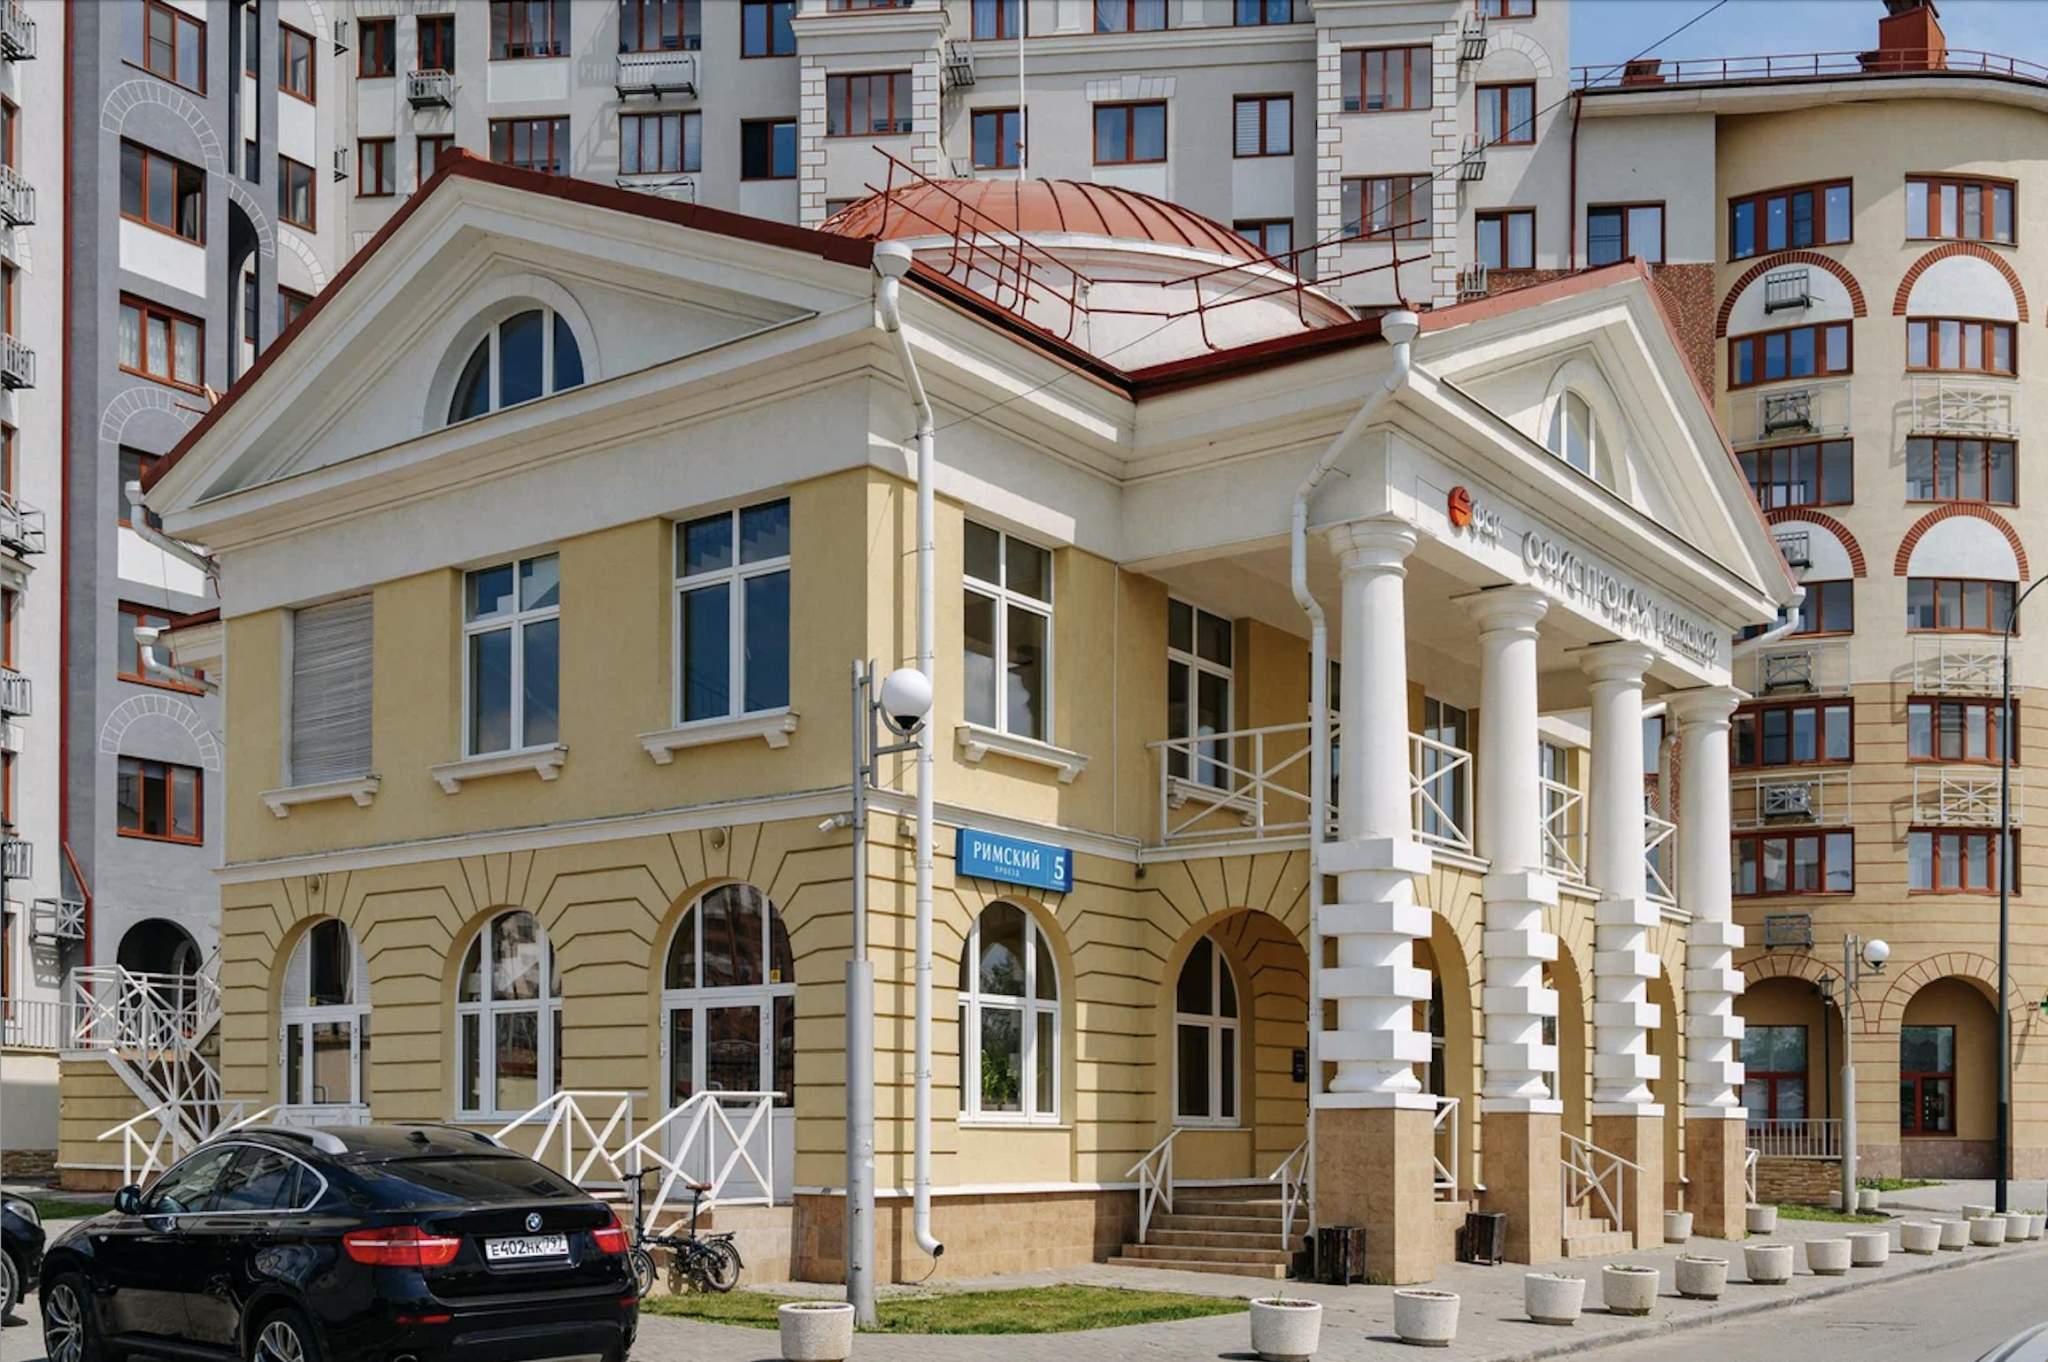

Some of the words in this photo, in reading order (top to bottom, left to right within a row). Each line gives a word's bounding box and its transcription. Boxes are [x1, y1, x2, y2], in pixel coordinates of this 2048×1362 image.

[1523, 531, 1585, 590] ОФИС
[1586, 564, 1655, 632] ПРОДАЖ
[973, 841, 1040, 870] РИМСКИЙ
[1054, 856, 1064, 880] 5
